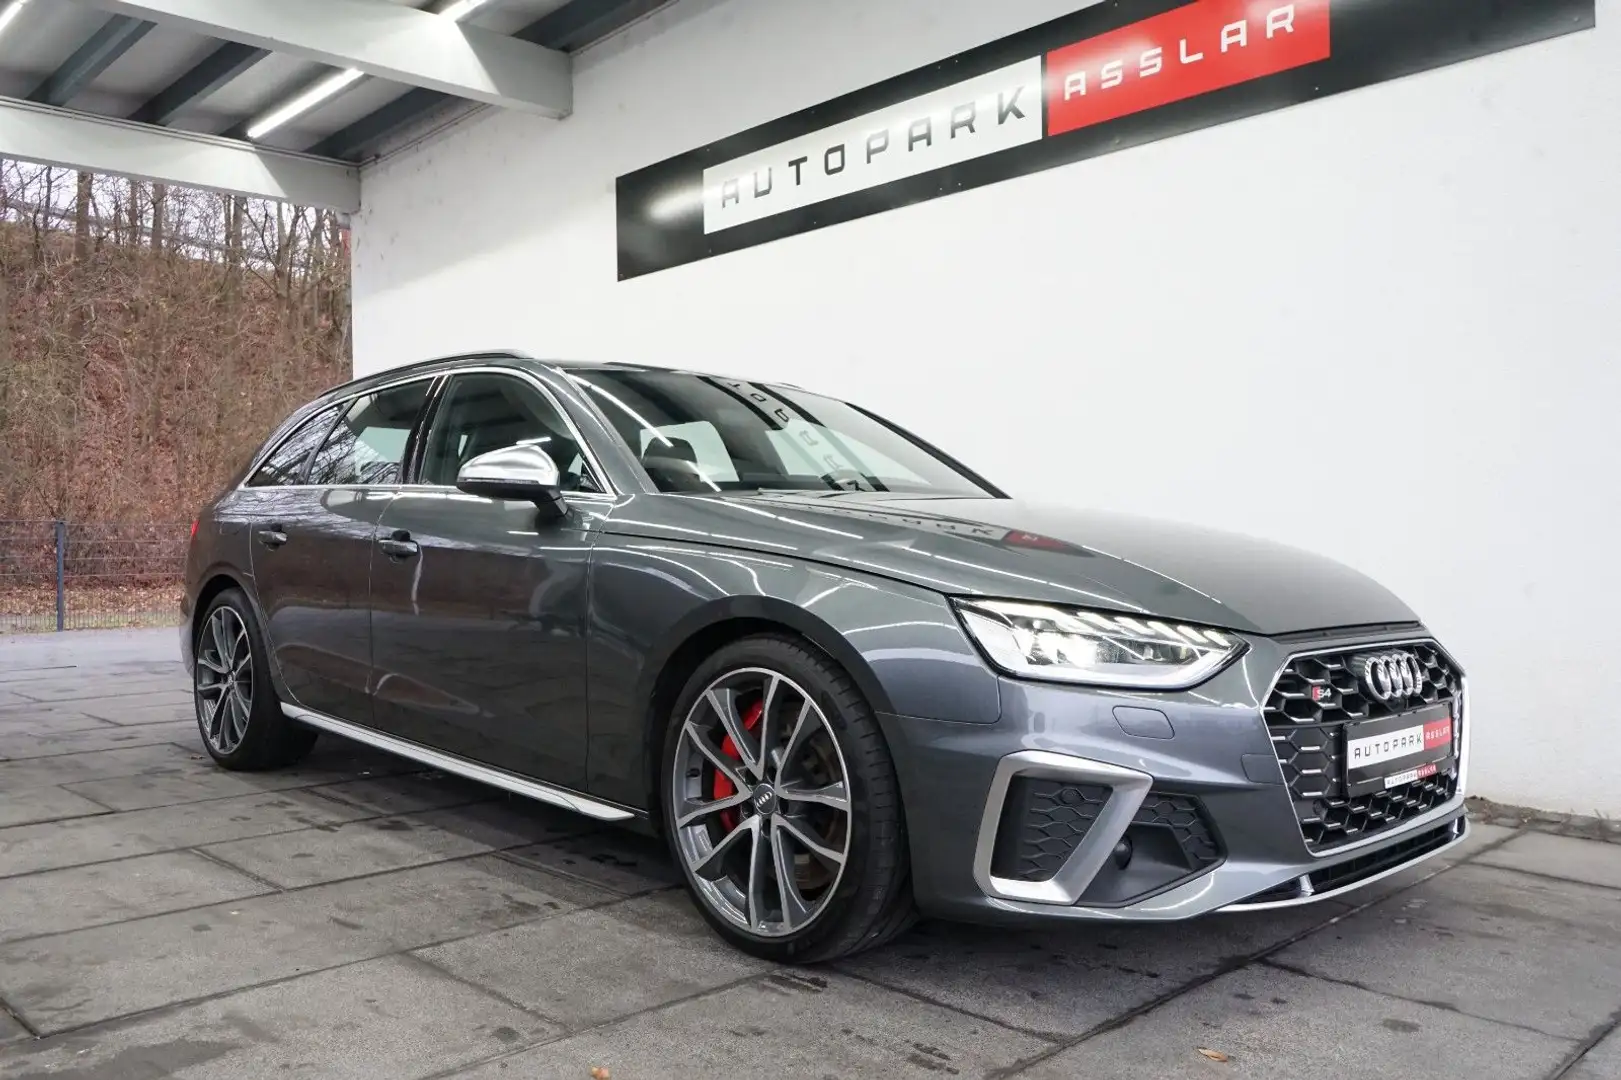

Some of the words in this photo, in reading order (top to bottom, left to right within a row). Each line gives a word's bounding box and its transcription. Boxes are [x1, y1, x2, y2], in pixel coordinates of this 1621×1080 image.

[721, 86, 1026, 209] AUTOPARK
[1063, 3, 1295, 101] ASSLAR
[1316, 687, 1332, 699] S4
[1354, 732, 1422, 760] AUTOPARK
